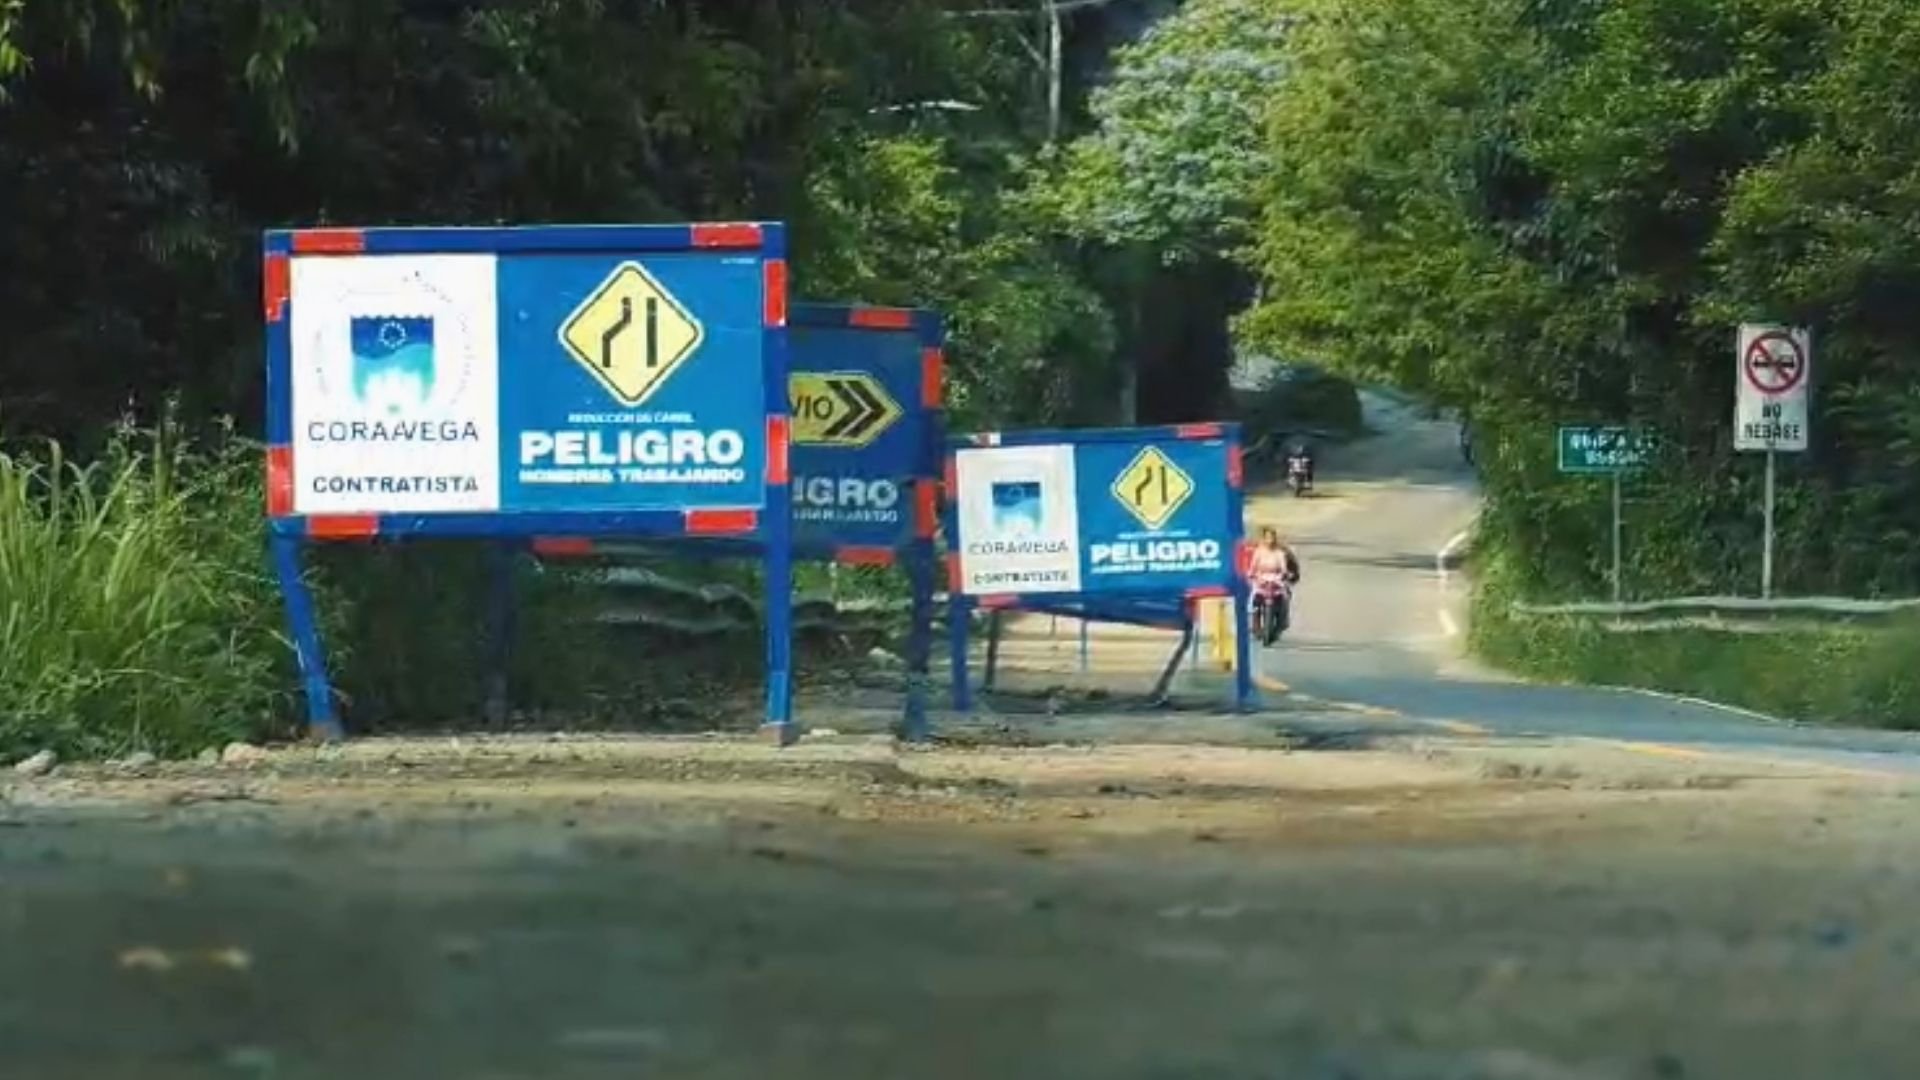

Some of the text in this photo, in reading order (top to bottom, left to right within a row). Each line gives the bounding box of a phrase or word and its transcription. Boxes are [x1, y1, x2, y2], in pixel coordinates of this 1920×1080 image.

[1761, 403, 1782, 418] NO
[519, 429, 745, 465] PELIGRO
[312, 475, 480, 494] CONTRATISTA
[518, 468, 745, 484] HOMBRES TRABAJANDO
[1089, 539, 1220, 564] PELIGRO
